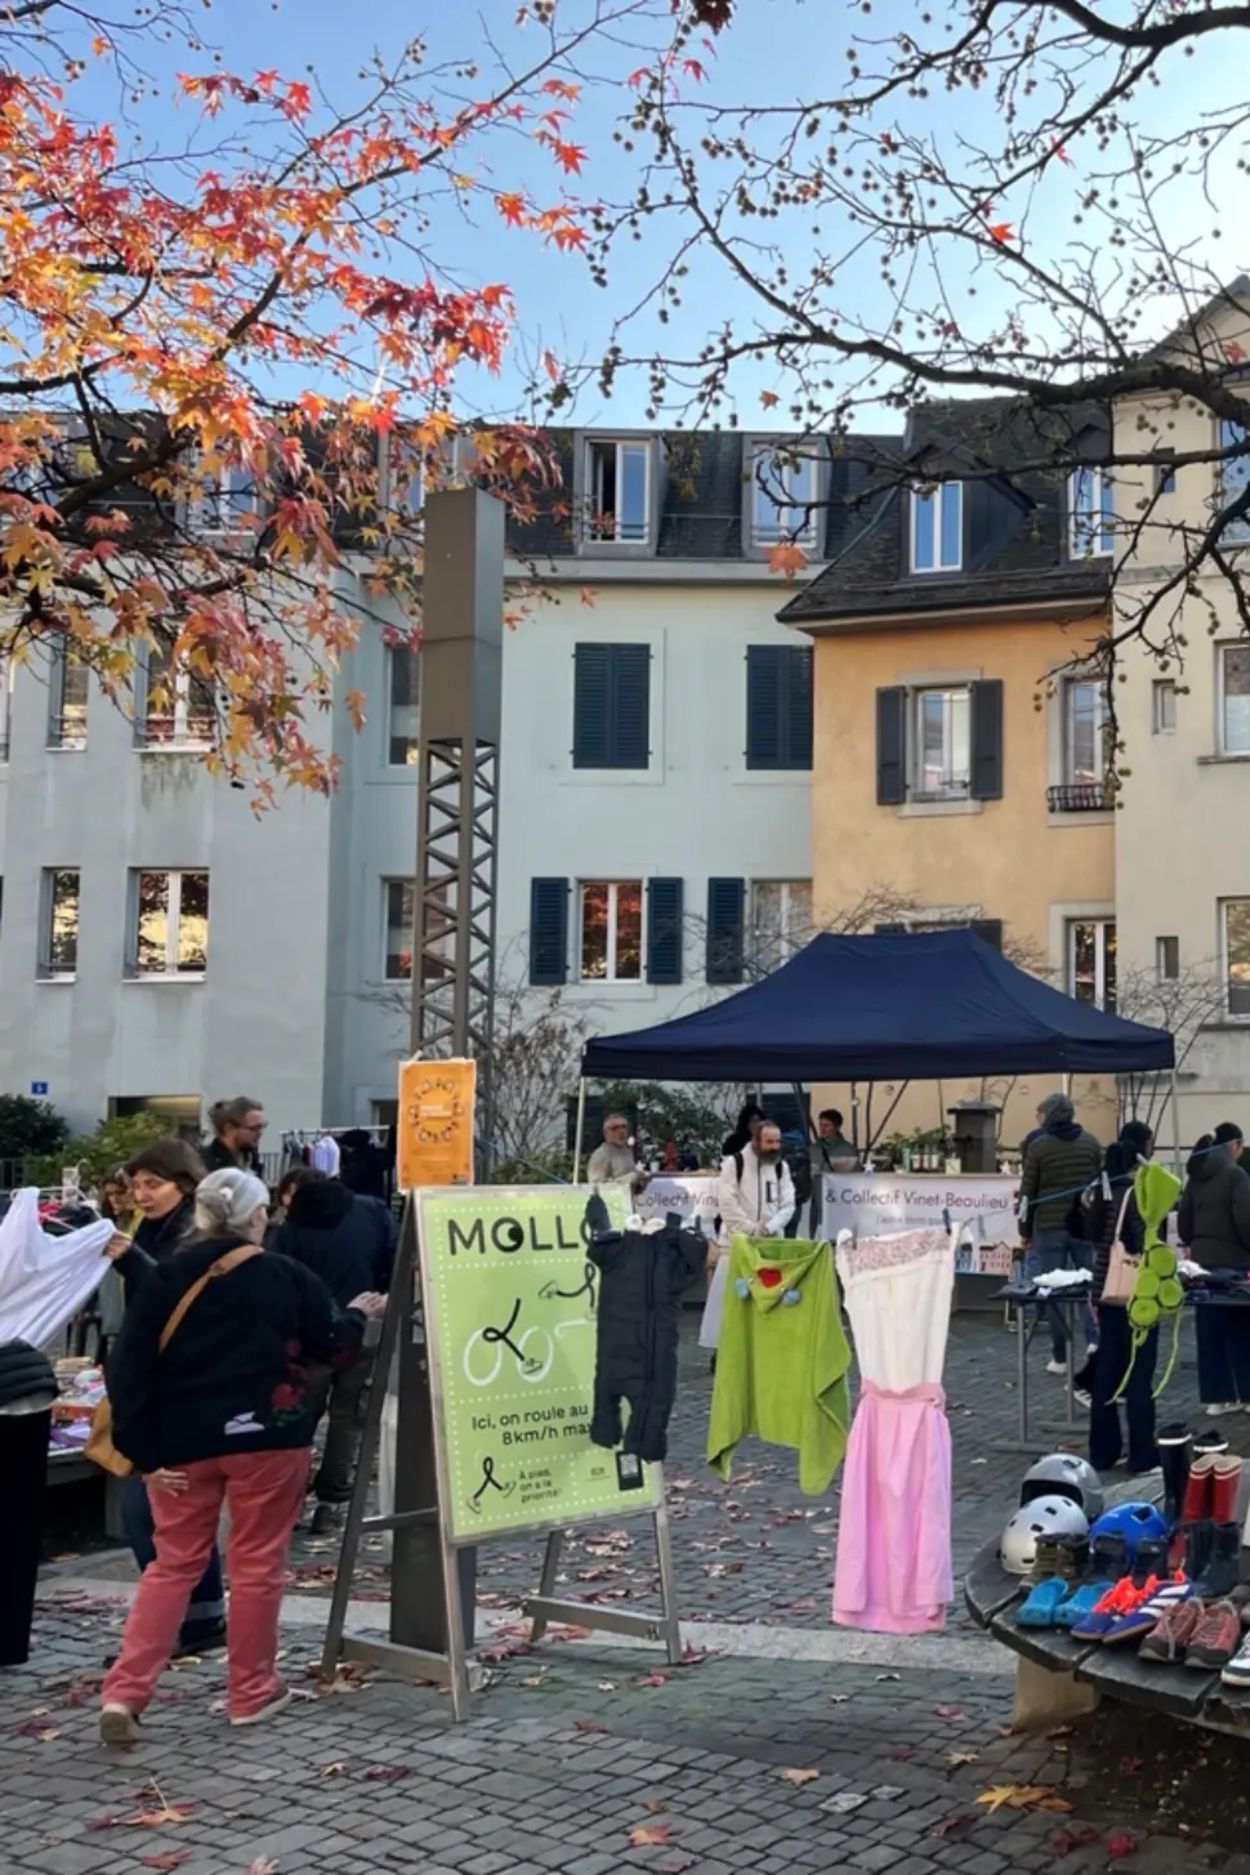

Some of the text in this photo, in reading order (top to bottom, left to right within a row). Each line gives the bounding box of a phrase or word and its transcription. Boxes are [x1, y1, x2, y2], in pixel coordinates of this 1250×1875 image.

[825, 1188, 1009, 1209] & Collectif Vinet-Beaulieu
[500, 1413, 521, 1427] on
[523, 1405, 566, 1423] roule
[569, 1404, 588, 1417] au
